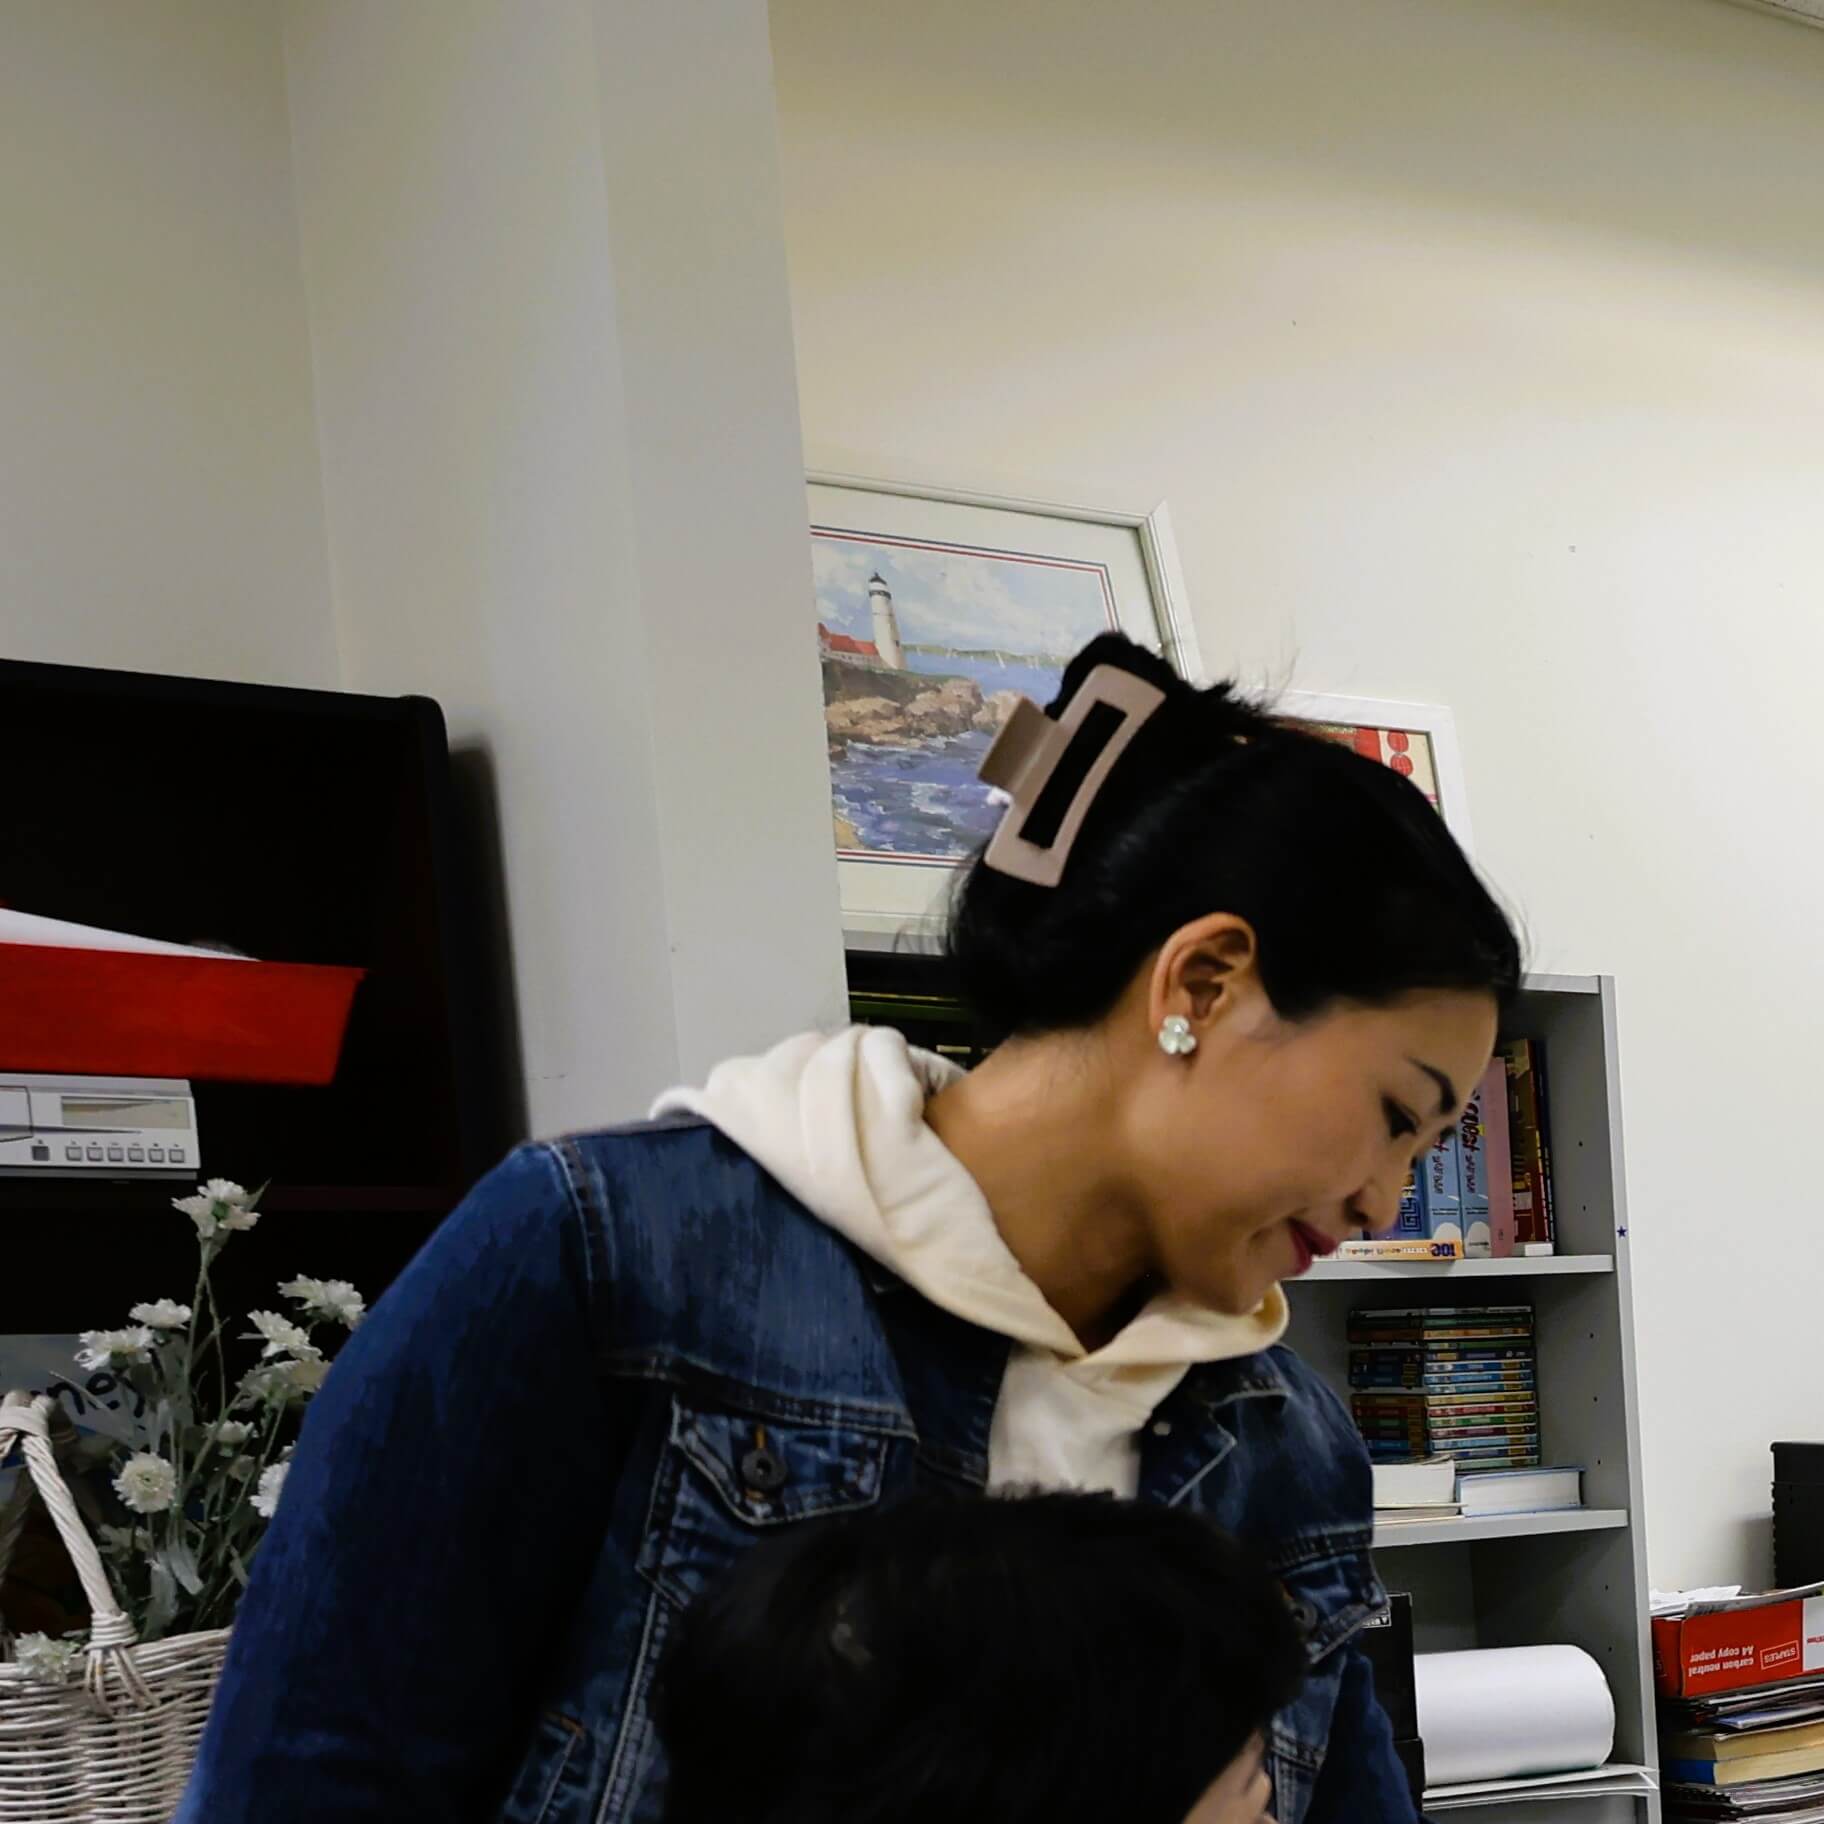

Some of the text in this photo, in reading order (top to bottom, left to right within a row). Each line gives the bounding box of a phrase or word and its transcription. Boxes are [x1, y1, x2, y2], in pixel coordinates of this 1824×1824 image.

[1689, 1645, 1754, 1664] A4 copy paper
[1764, 1647, 1797, 1664] STAPLES
[1688, 1657, 1754, 1676] carbon neutral
